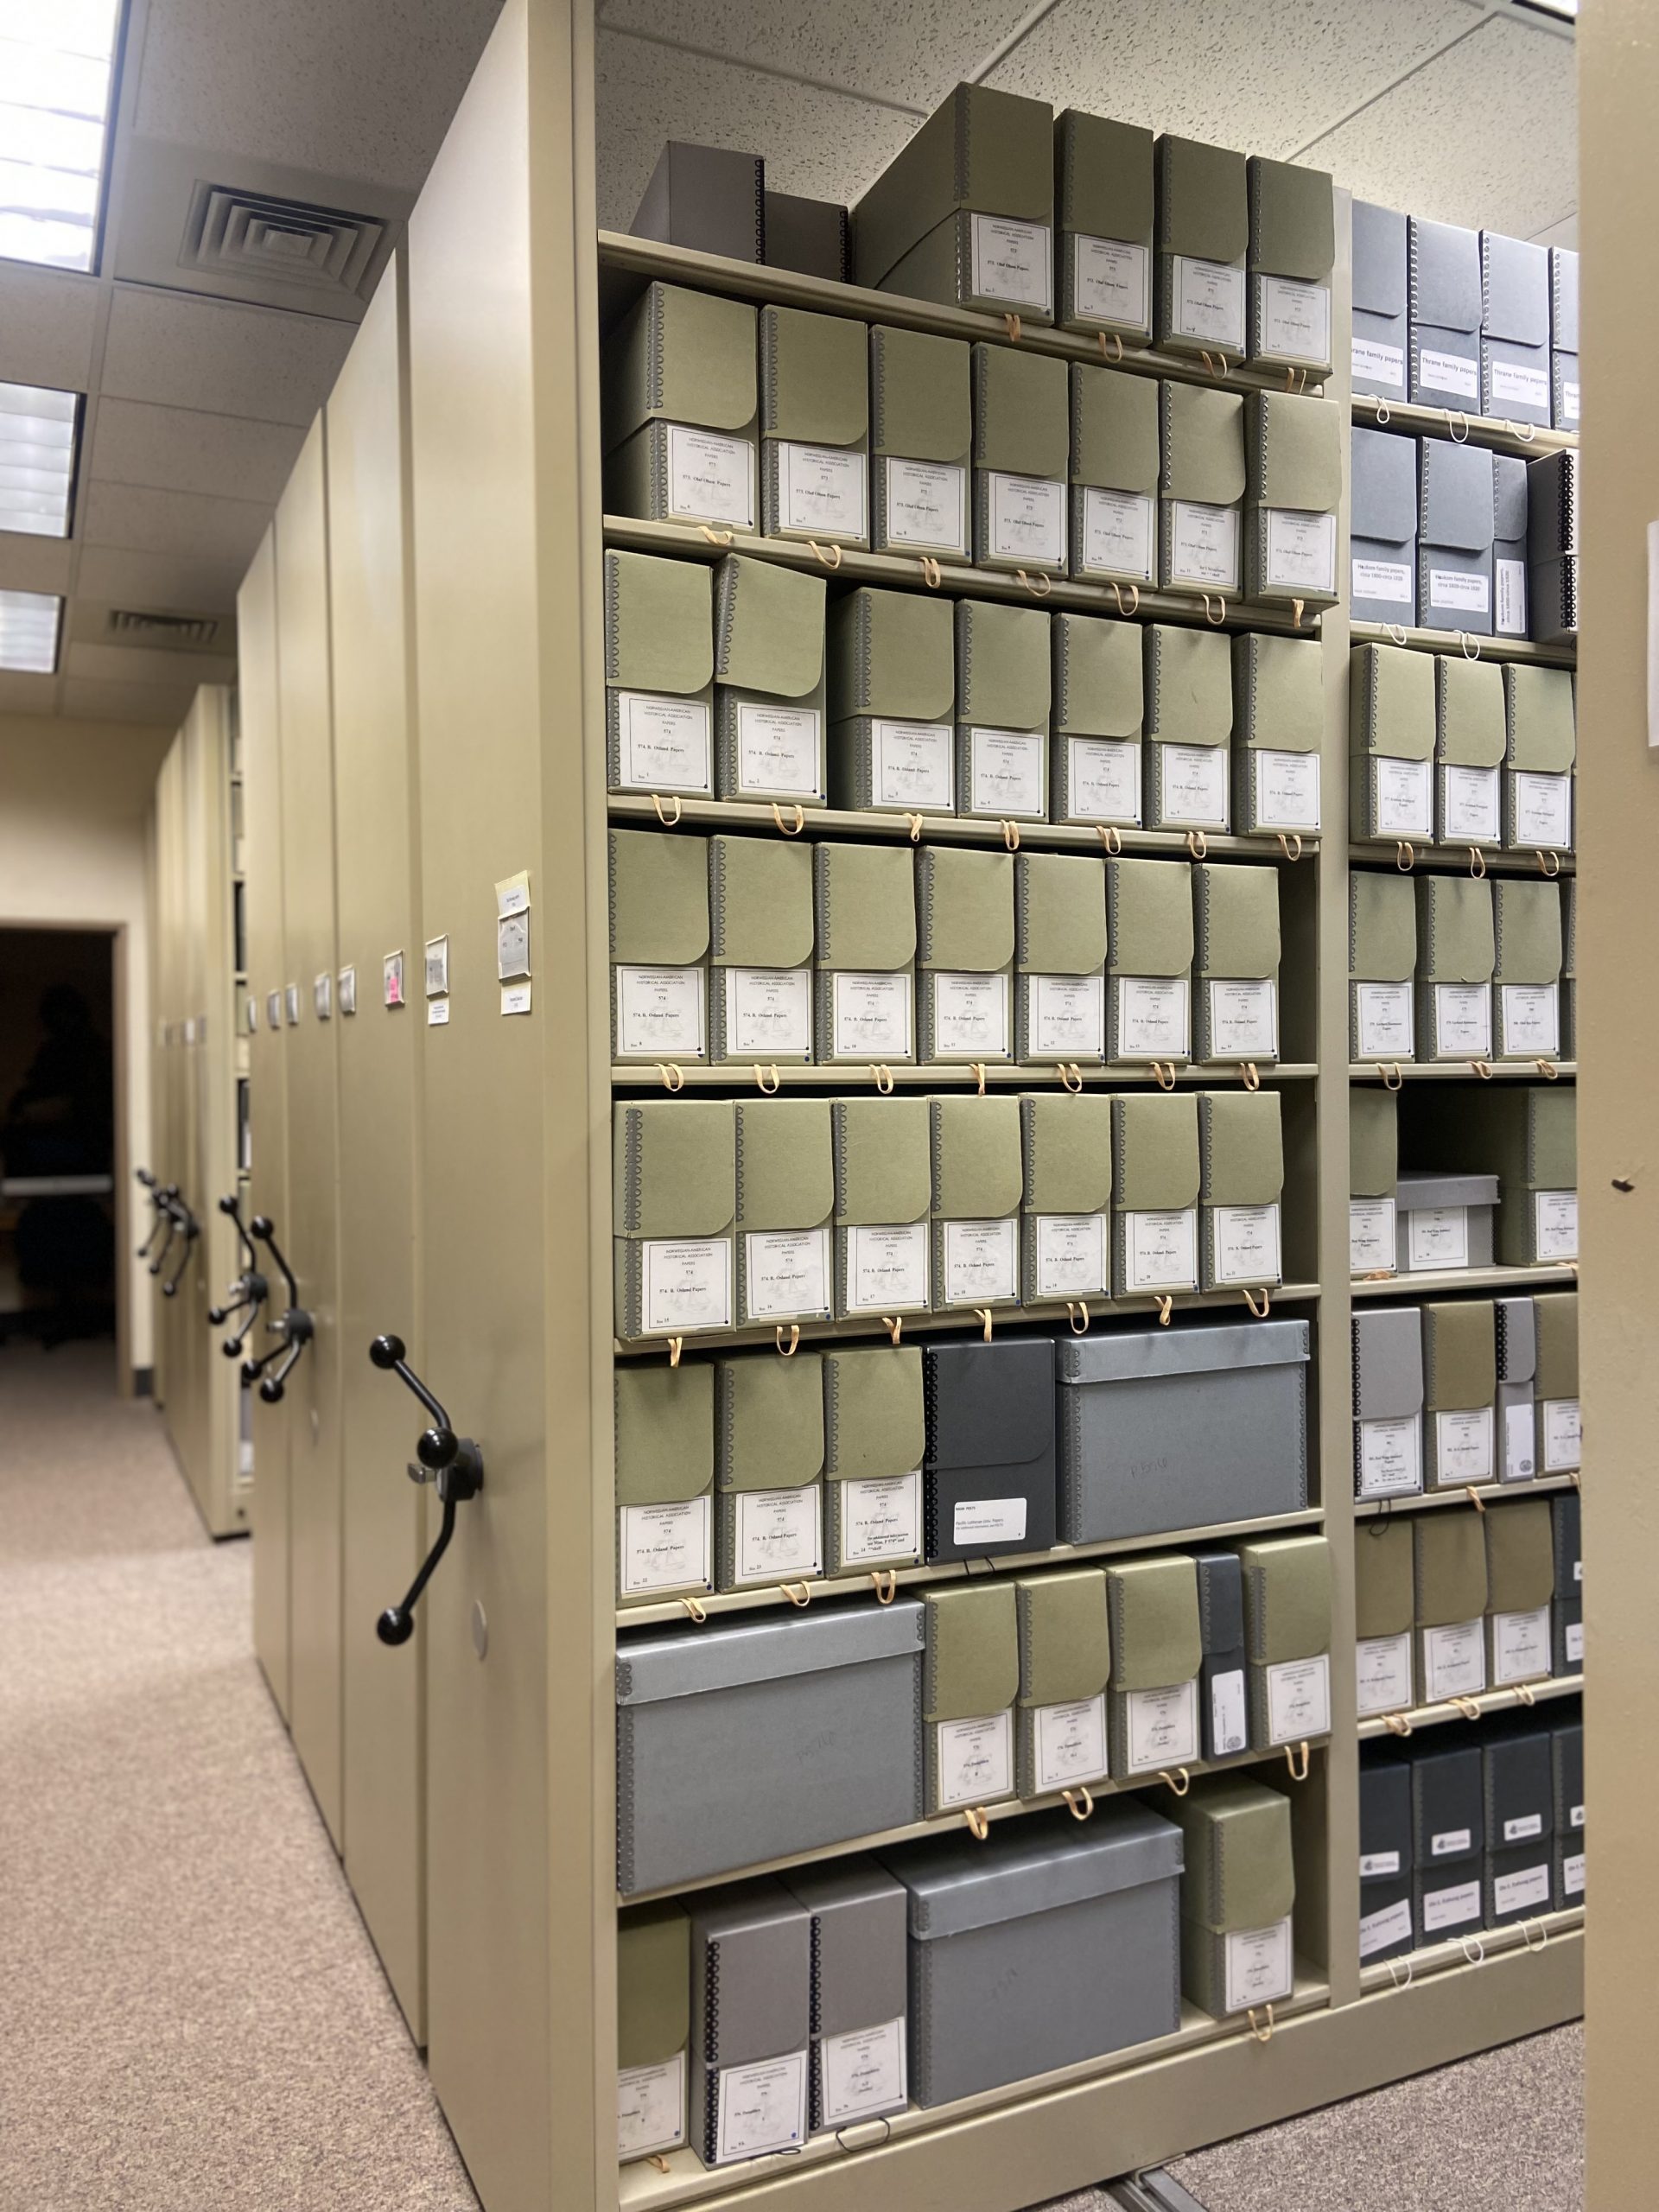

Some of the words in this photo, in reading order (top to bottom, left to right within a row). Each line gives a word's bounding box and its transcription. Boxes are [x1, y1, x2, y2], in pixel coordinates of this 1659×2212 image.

[1367, 351, 1383, 361] family
[1422, 357, 1440, 366] Thrane
[1442, 362, 1459, 372] family
[1459, 366, 1477, 376] papers
[1494, 369, 1511, 378] Thrane
[1513, 372, 1529, 384] family
